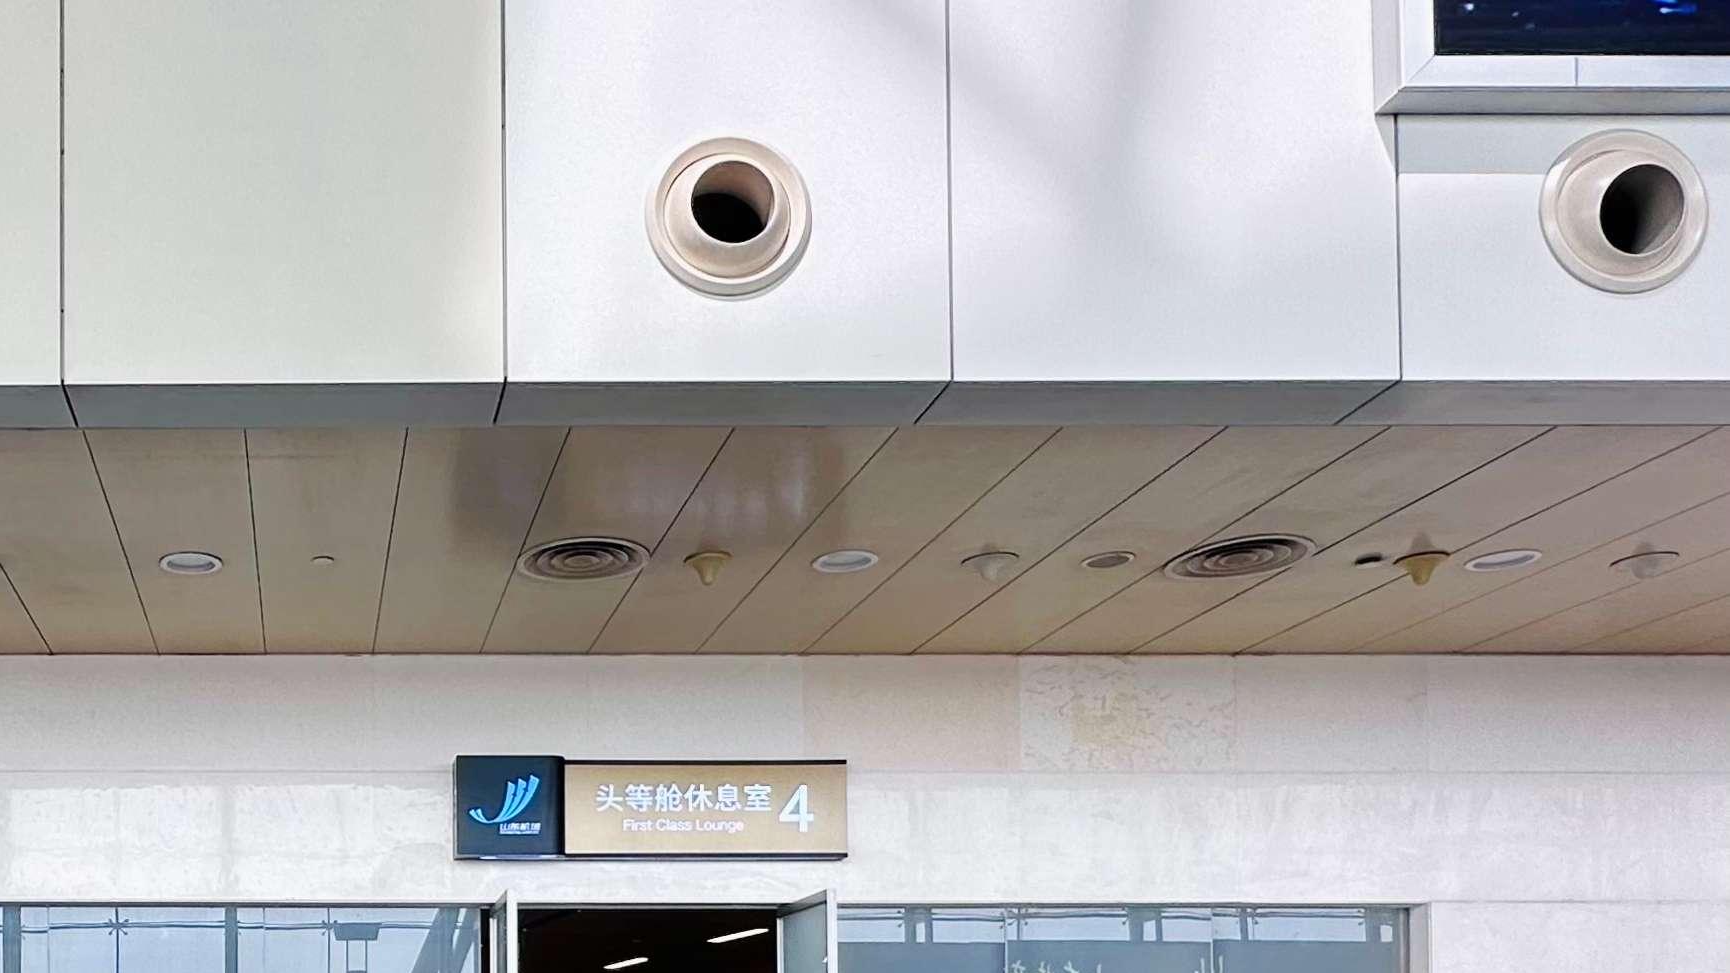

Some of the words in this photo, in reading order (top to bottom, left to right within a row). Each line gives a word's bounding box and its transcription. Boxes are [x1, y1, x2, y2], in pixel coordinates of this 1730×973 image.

[596, 783, 771, 812] 头等舱休息室
[778, 784, 815, 832] 4
[622, 818, 653, 832] First
[655, 818, 692, 832] Class
[695, 818, 744, 834] Lounge
